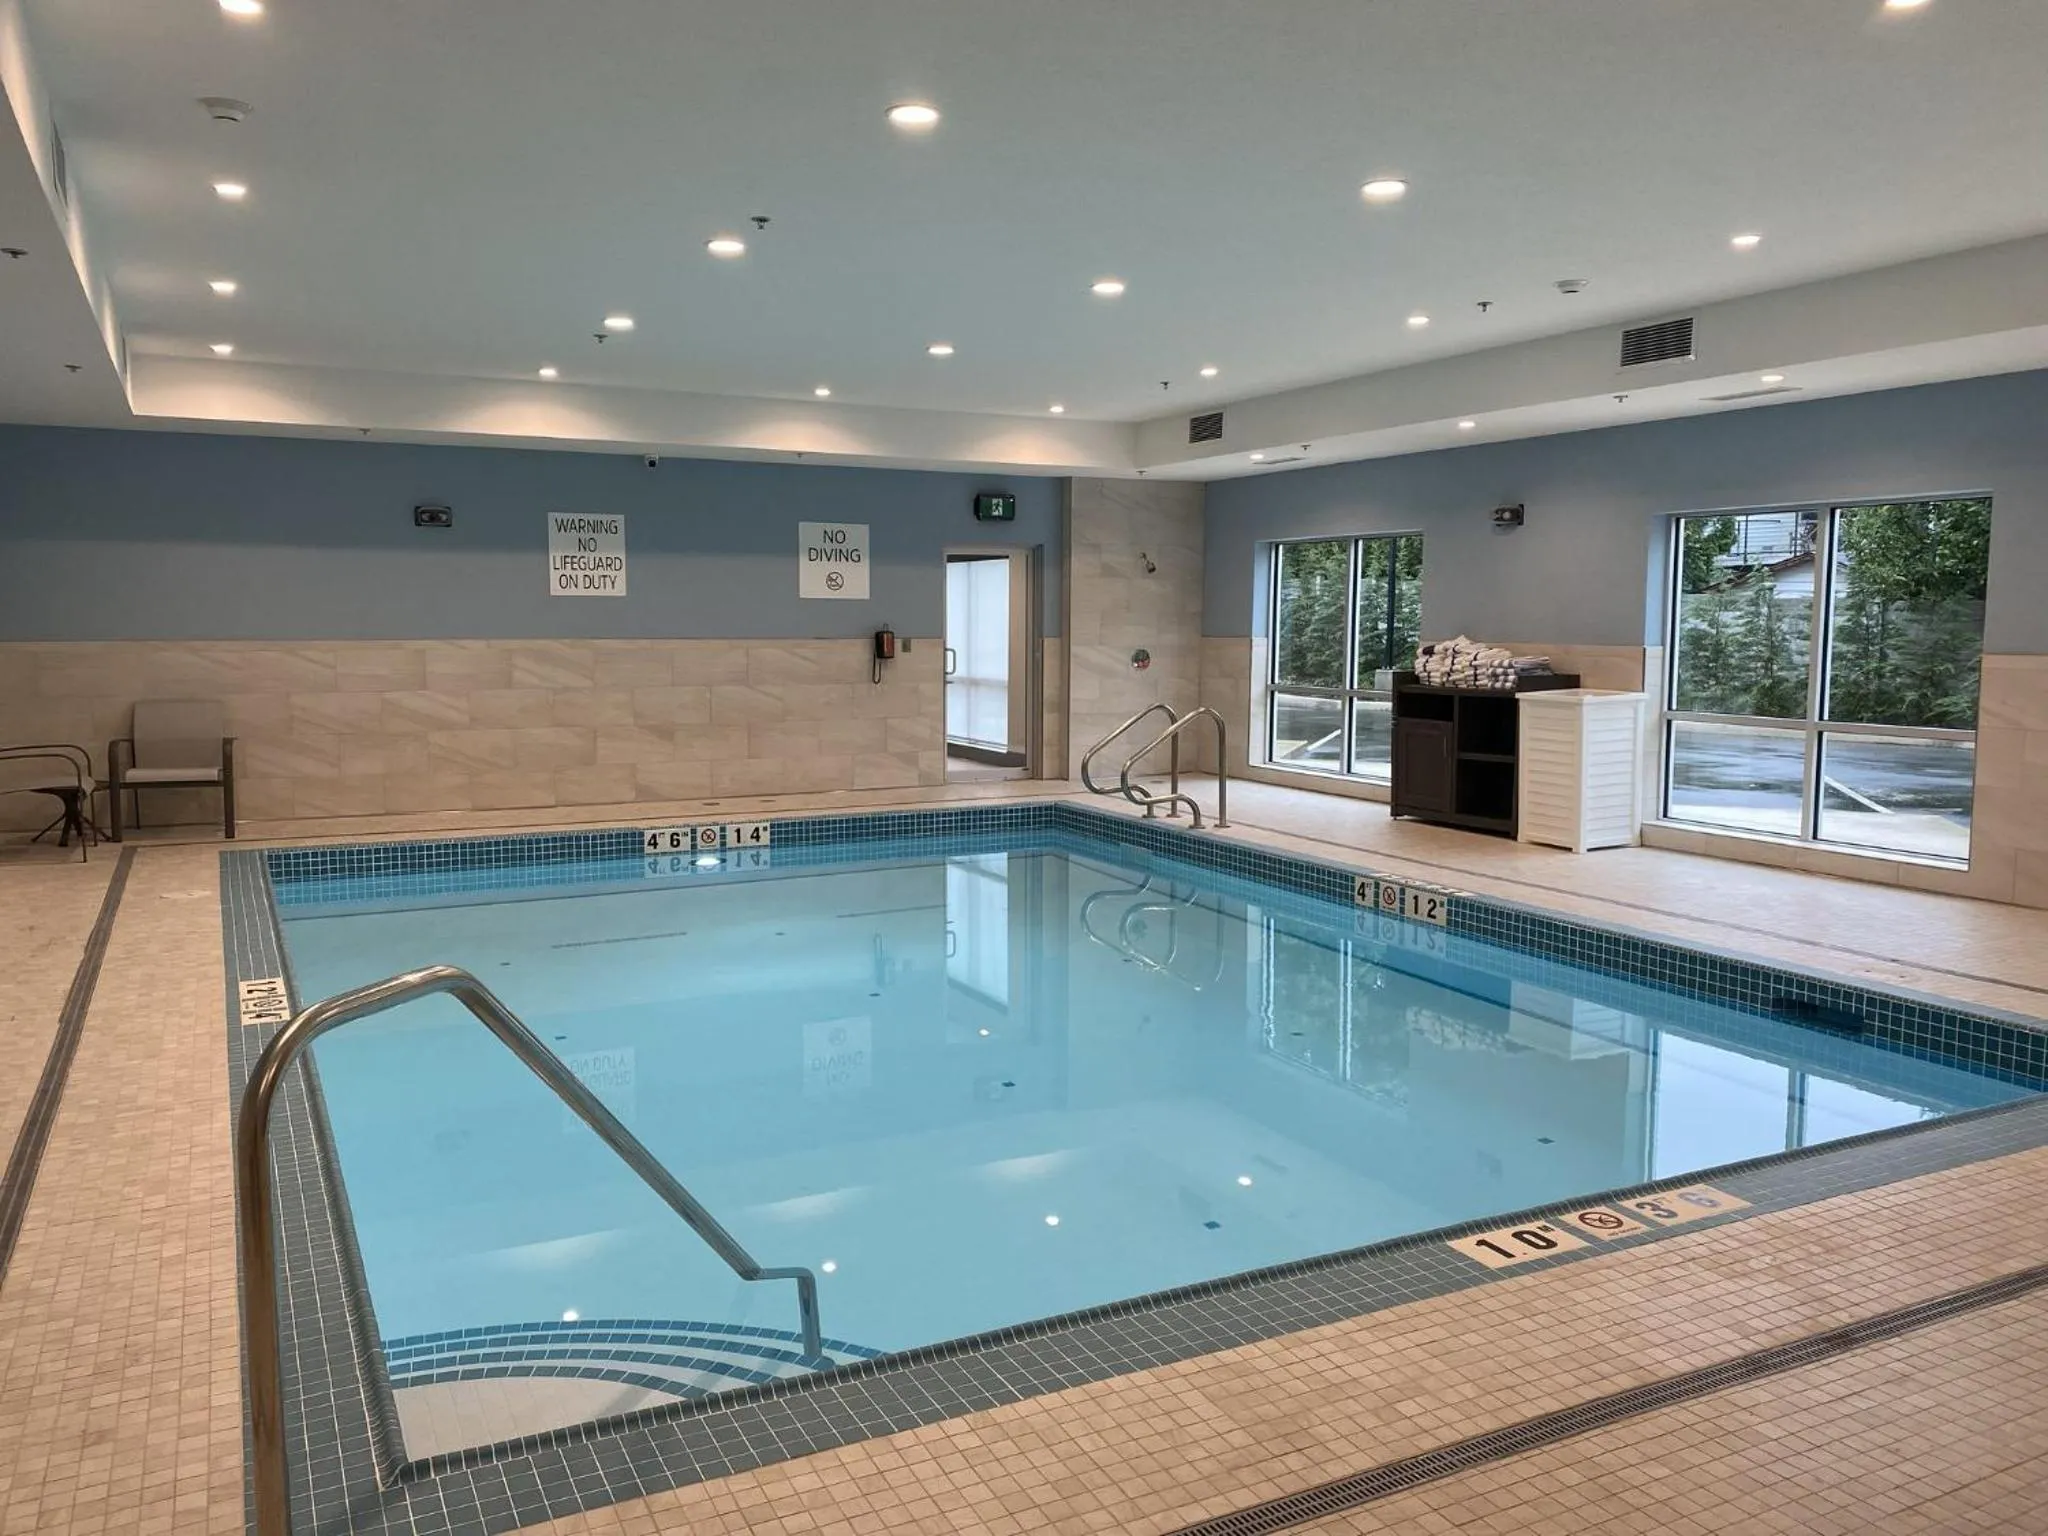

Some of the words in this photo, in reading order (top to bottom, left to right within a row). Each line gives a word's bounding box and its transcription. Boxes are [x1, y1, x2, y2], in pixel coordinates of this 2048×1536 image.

[555, 517, 618, 534] WARNING
[578, 536, 598, 552] NO
[823, 529, 846, 544] NO
[552, 555, 624, 571] LIFEGUARD
[808, 547, 861, 563] DIVING
[559, 573, 578, 589] ON
[583, 574, 618, 590] DUTY
